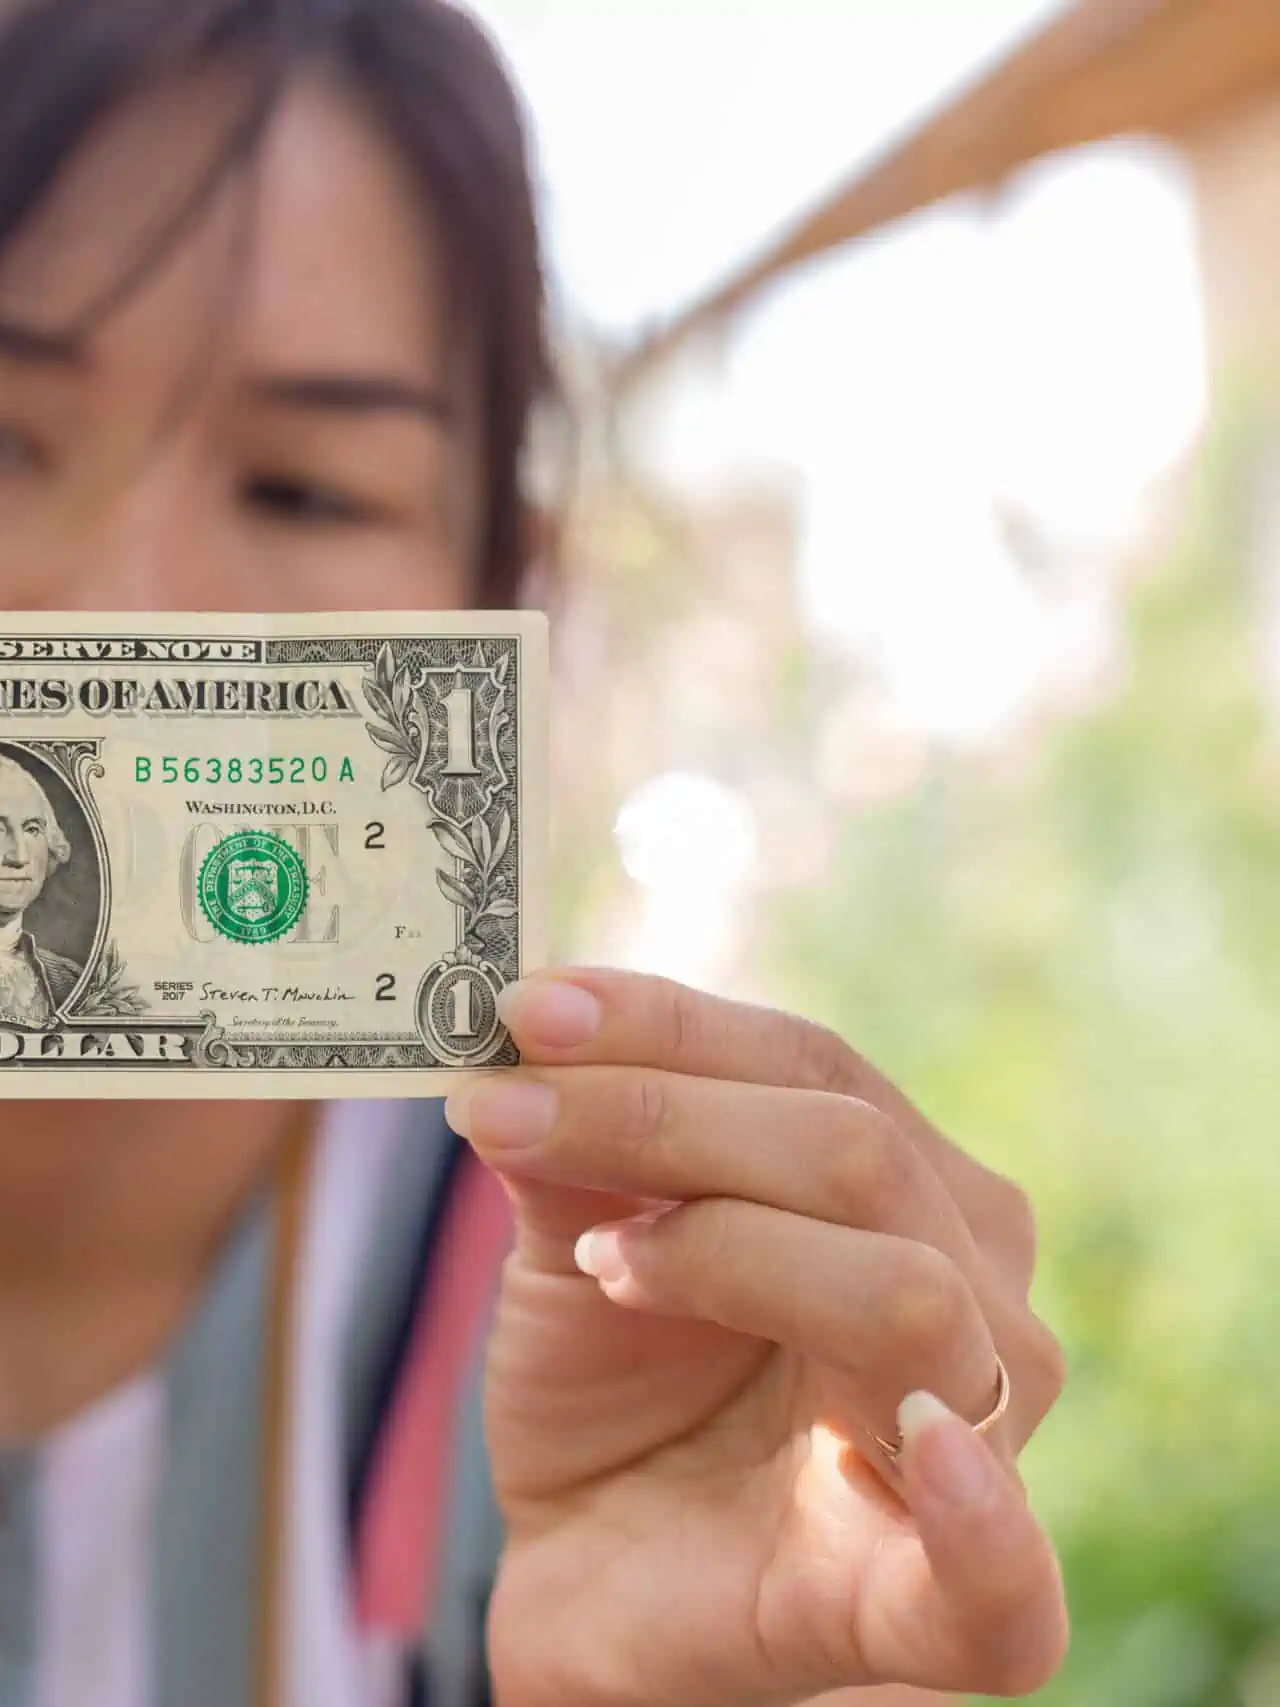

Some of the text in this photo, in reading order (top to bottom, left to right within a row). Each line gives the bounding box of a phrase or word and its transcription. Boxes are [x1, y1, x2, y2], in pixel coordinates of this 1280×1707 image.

[140, 642, 258, 660] NOTE
[79, 678, 144, 718] OF
[144, 678, 362, 718] AMERICA
[440, 688, 482, 776] 1
[364, 822, 385, 849] 2
[153, 981, 194, 991] SERIES
[162, 991, 185, 1001] 2017
[199, 981, 259, 1002] Steven
[375, 973, 397, 1001] 2
[448, 979, 479, 1038] 1
